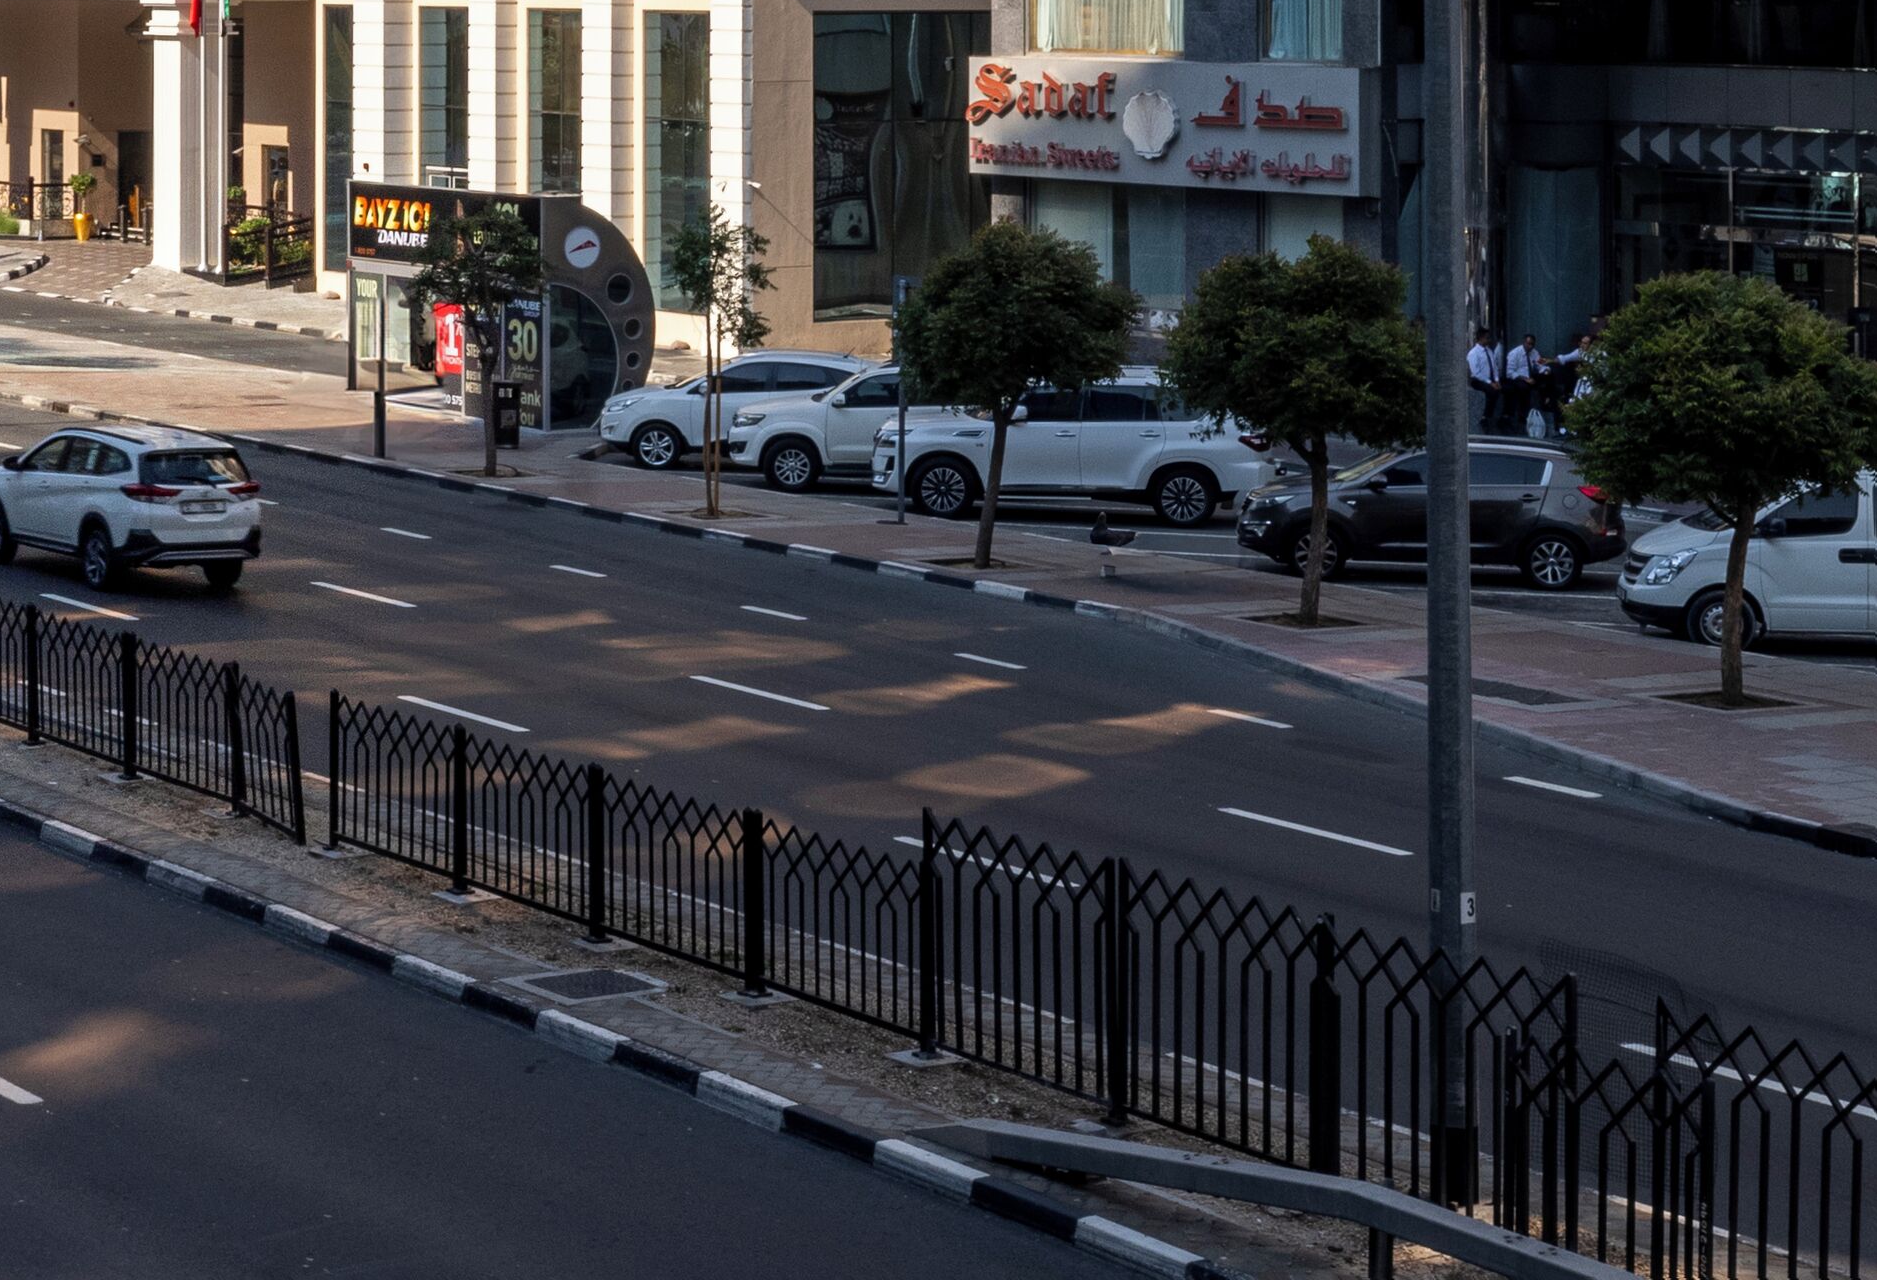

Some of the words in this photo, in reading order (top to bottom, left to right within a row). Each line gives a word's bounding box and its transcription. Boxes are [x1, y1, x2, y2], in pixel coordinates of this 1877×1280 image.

[965, 63, 1117, 126] Sadaf
[969, 137, 1044, 168] Iranian
[1046, 141, 1119, 171] Sweets
[353, 195, 401, 230] BAYZ
[402, 201, 432, 233] 101
[377, 229, 429, 248] DANUBE
[355, 276, 378, 299] YOUR
[507, 318, 538, 363] 30
[520, 390, 542, 407] ank
[1467, 896, 1475, 918] 3
